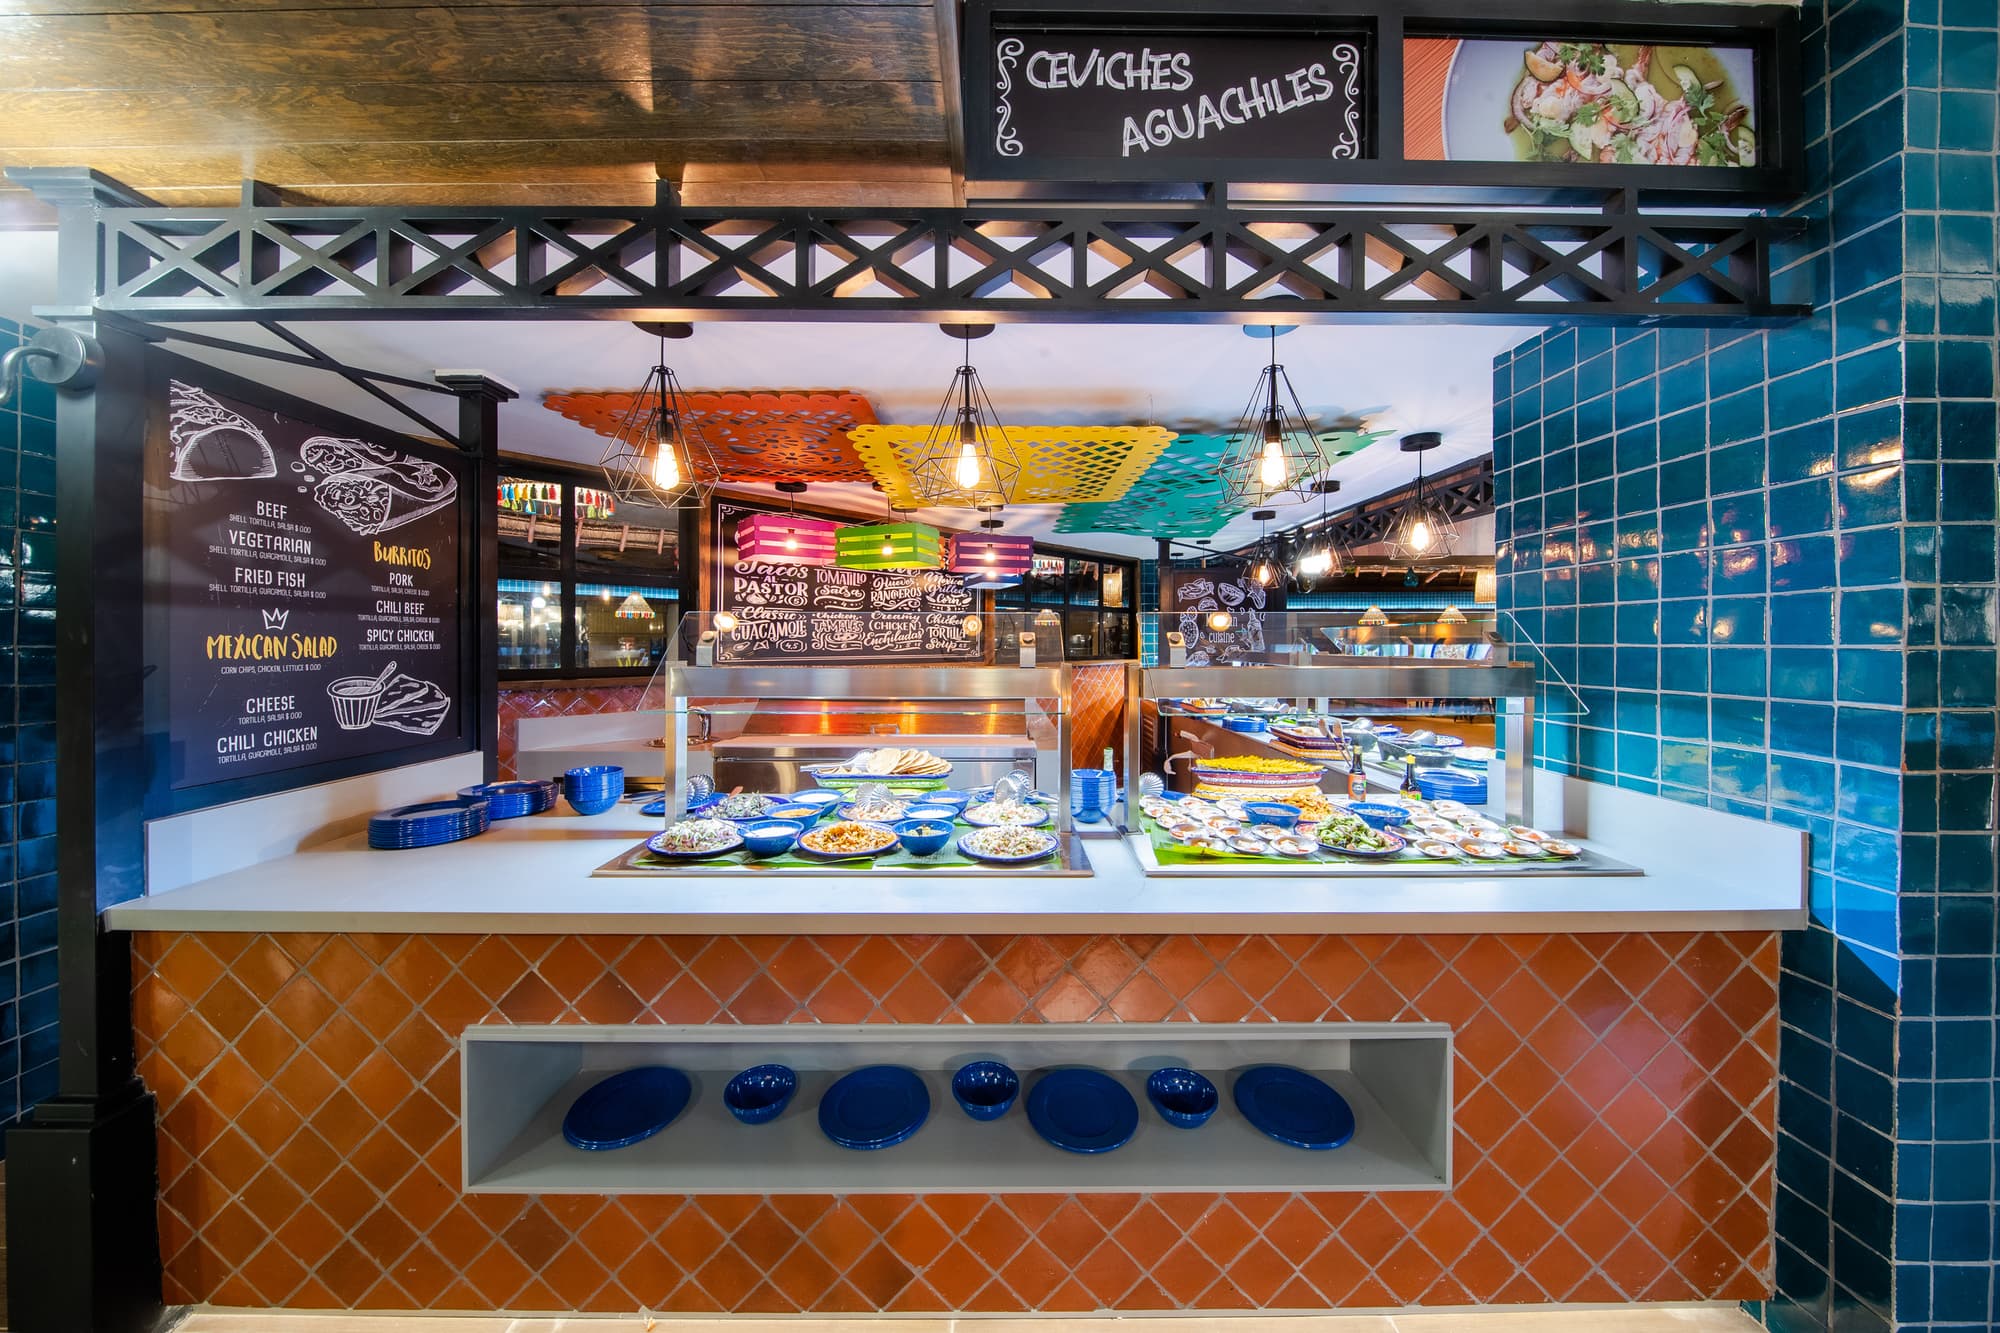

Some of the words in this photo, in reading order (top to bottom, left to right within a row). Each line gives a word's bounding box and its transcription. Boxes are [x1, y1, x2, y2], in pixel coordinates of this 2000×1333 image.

[1026, 47, 1194, 91] CEVICHES
[1122, 62, 1334, 157] AGUACHILES
[256, 500, 288, 520] BEEF
[229, 514, 247, 524] SHELL
[277, 522, 295, 531] SALSA
[228, 529, 312, 555] VEGETARIAN
[209, 545, 228, 555] SHELL
[294, 555, 310, 564] SALSA
[235, 567, 273, 585] FRIED
[277, 571, 306, 588] FISH
[734, 560, 809, 579] Tacos
[814, 568, 868, 587] TOMATILLO
[389, 572, 414, 587] PORK
[733, 577, 809, 597] PASTOR
[763, 575, 778, 583] AL
[873, 576, 916, 590] Huevos
[209, 584, 227, 593] SHELL
[294, 589, 310, 598] SALSA
[376, 600, 402, 614] CHILI
[404, 602, 425, 615] BEEF
[936, 594, 962, 606] Corn
[741, 606, 797, 620] Classic
[871, 610, 920, 623] Creamy
[731, 620, 808, 641] GUACAMOLE
[811, 619, 865, 634] TAMALES
[366, 628, 394, 642] SPICY
[397, 629, 435, 642] CHICKEN
[863, 630, 923, 649] Enchiladas
[1208, 632, 1235, 643] cuisine
[206, 633, 289, 661] MEXICAN
[291, 633, 338, 660] SALAD
[926, 637, 957, 652] Soup
[220, 666, 237, 675] CORN
[282, 664, 305, 673] LETTUCE
[246, 695, 296, 714] CHEESE
[267, 713, 285, 723] SALSA
[217, 733, 255, 754] CHILI
[263, 726, 318, 747] CHICKEN
[283, 745, 301, 755] SALSA
